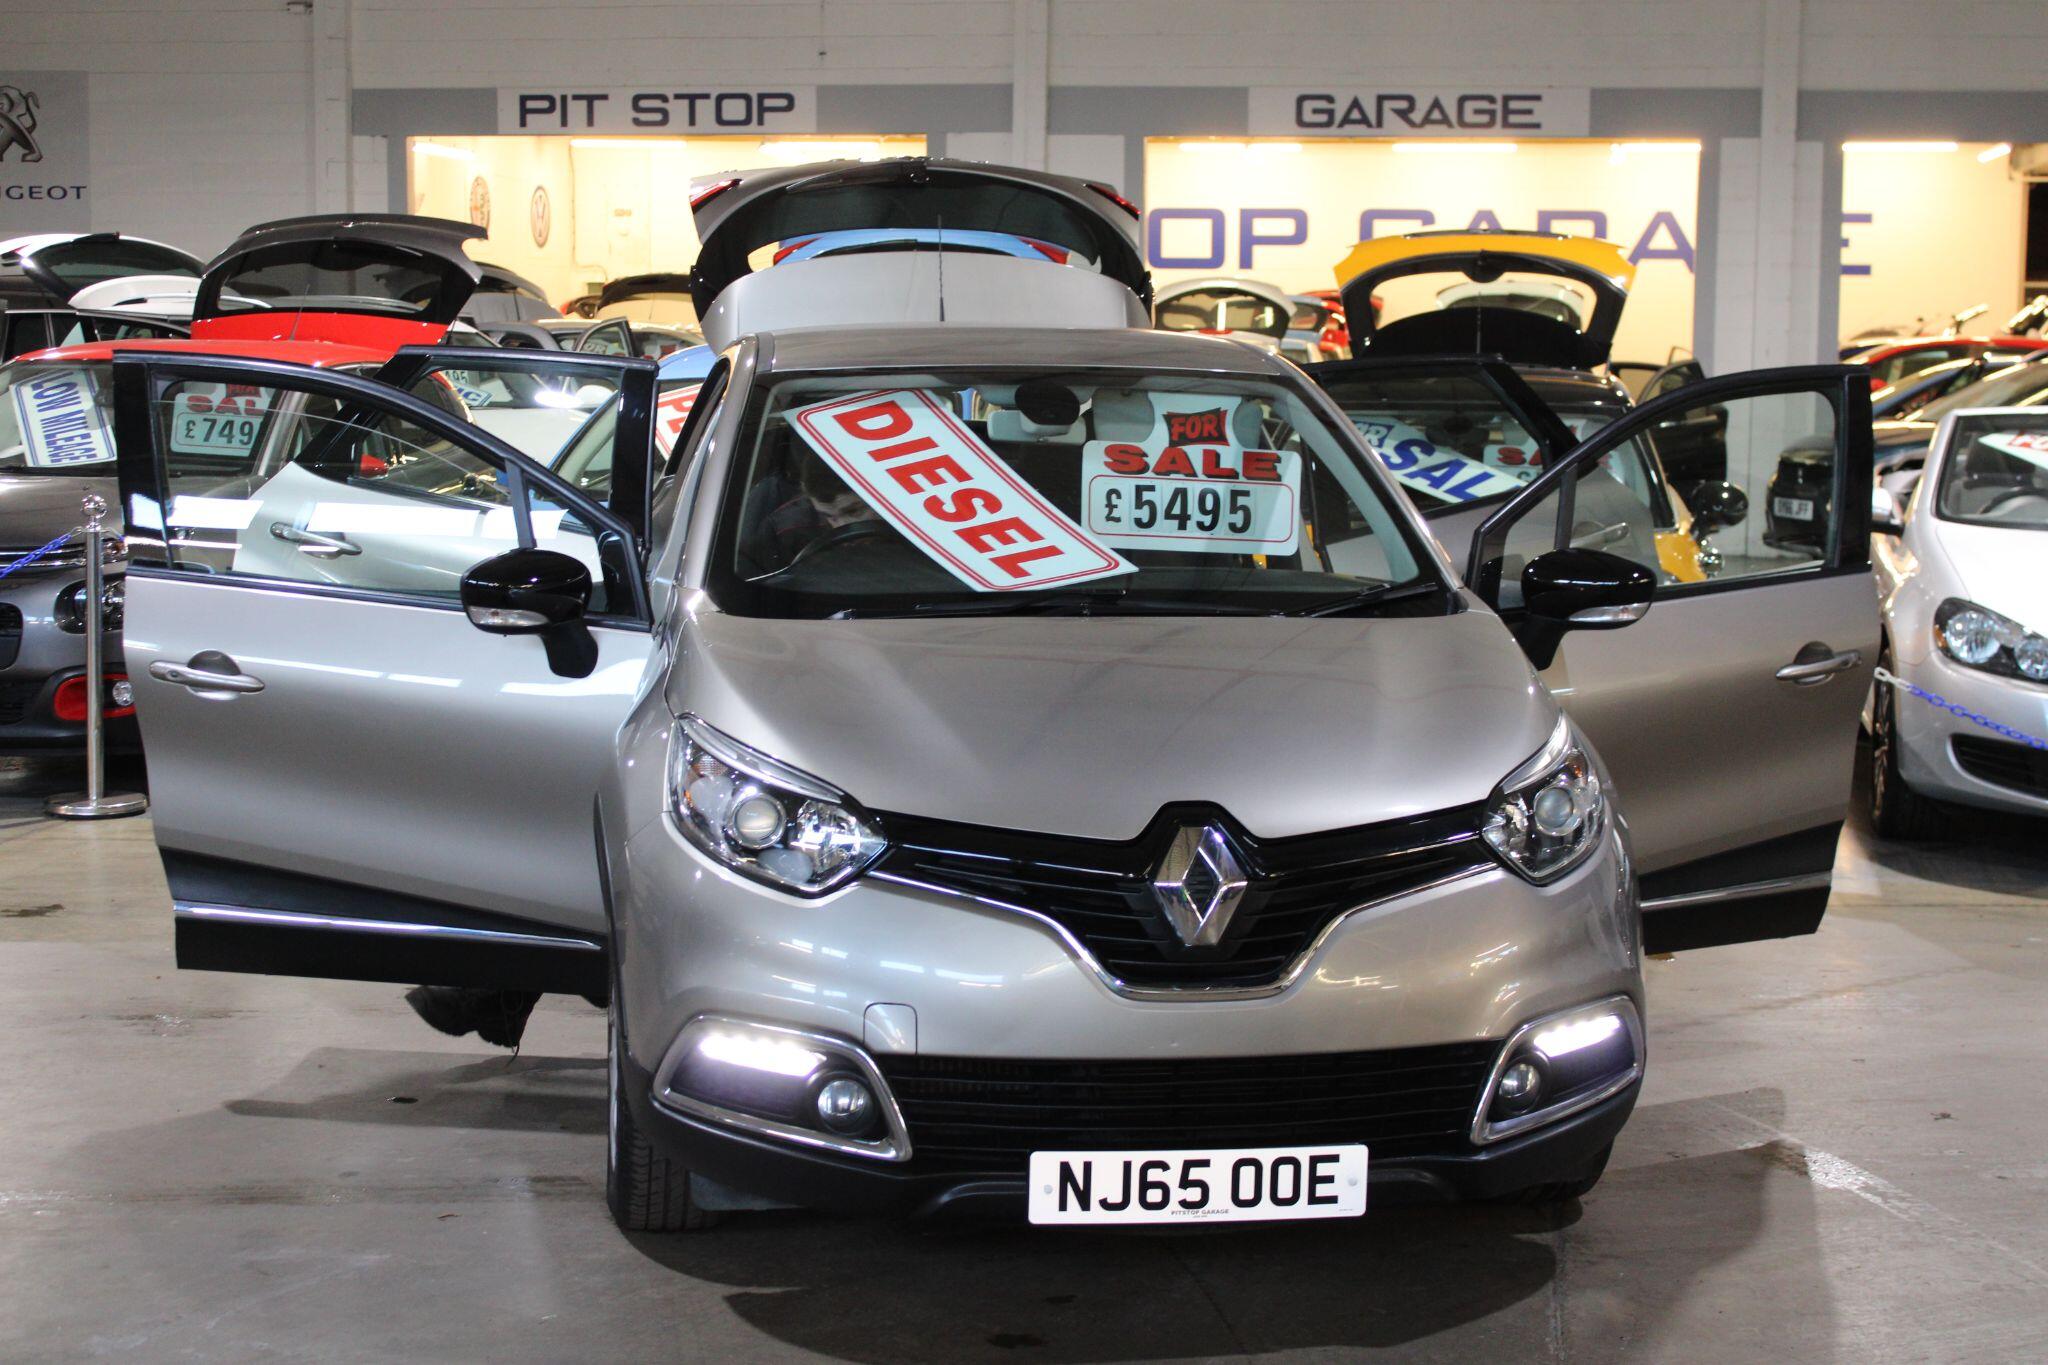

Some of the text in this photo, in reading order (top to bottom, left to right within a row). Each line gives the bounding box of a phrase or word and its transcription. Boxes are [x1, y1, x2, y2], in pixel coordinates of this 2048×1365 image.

[519, 93, 795, 127] PIT STOP
[1295, 94, 1542, 129] GARAGE
[0, 185, 87, 200] GEOT
[31, 371, 98, 464] LOW MILEAGE
[1170, 414, 1219, 441] FOR
[1104, 443, 1282, 482] SALE
[832, 400, 1065, 579] DIESEL
[1058, 1158, 1211, 1212] NJ65
